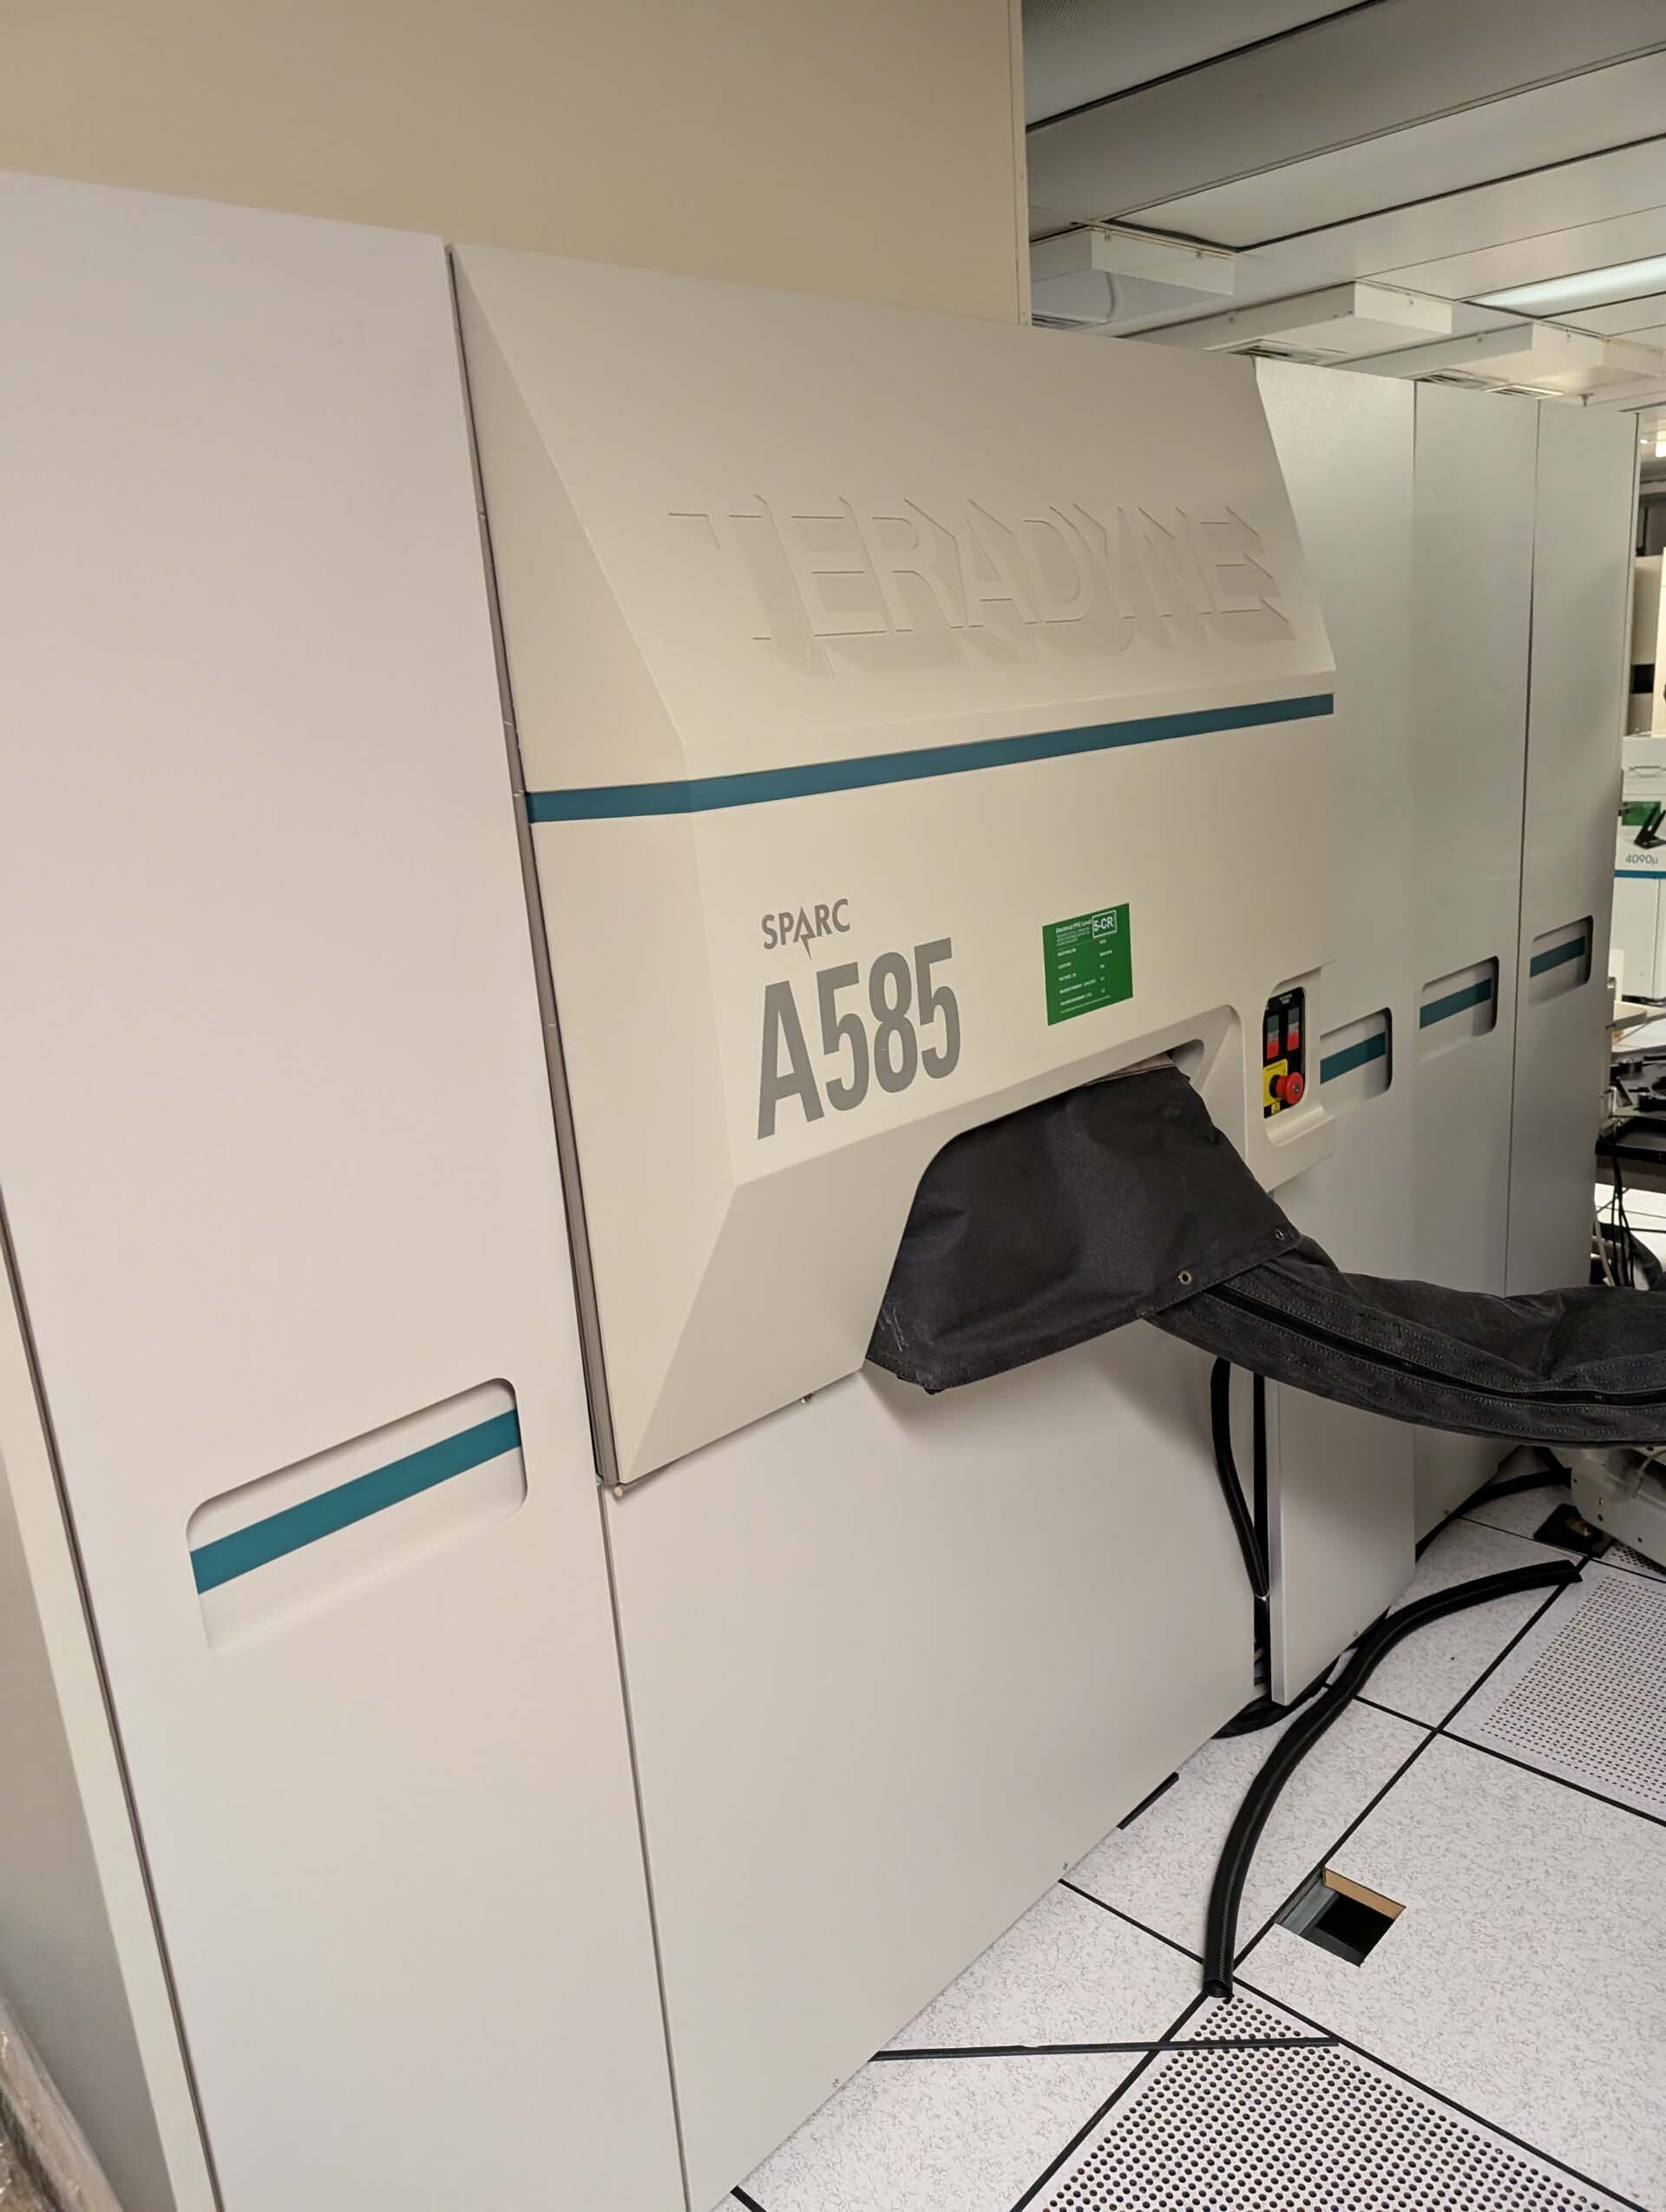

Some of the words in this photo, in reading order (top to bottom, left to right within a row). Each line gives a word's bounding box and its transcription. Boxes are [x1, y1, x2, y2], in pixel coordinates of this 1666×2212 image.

[667, 494, 1294, 646] TERADYNE
[761, 898, 851, 960] SPARC
[758, 937, 961, 1140] A585
